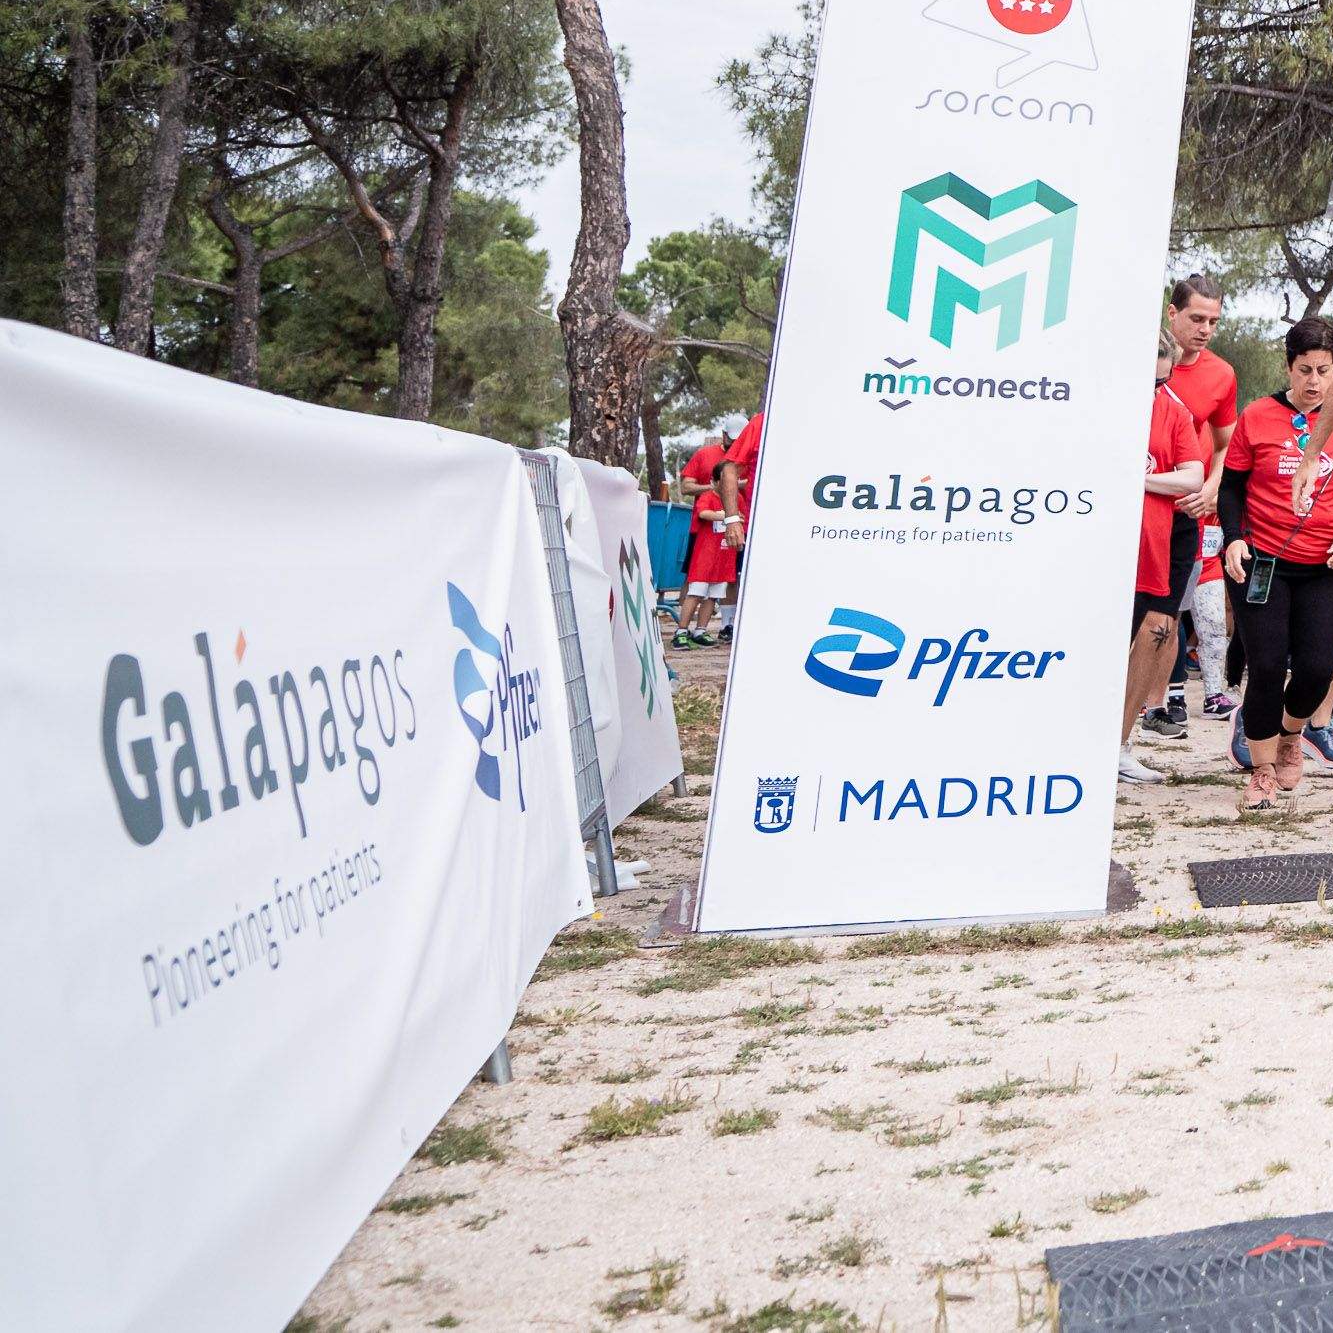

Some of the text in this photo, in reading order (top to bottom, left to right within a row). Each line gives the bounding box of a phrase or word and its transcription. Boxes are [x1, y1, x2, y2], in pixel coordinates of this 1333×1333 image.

[915, 89, 1094, 125] sorcom
[863, 371, 1071, 401] mmconecta
[813, 474, 1094, 524] Galápagos
[811, 525, 1014, 544] Pioneering for patients
[907, 628, 1066, 707] Pfizer
[102, 623, 541, 846] Galápagos Pfizer
[839, 774, 1084, 823] MADRID
[143, 839, 382, 1028] Pioneering for patients
